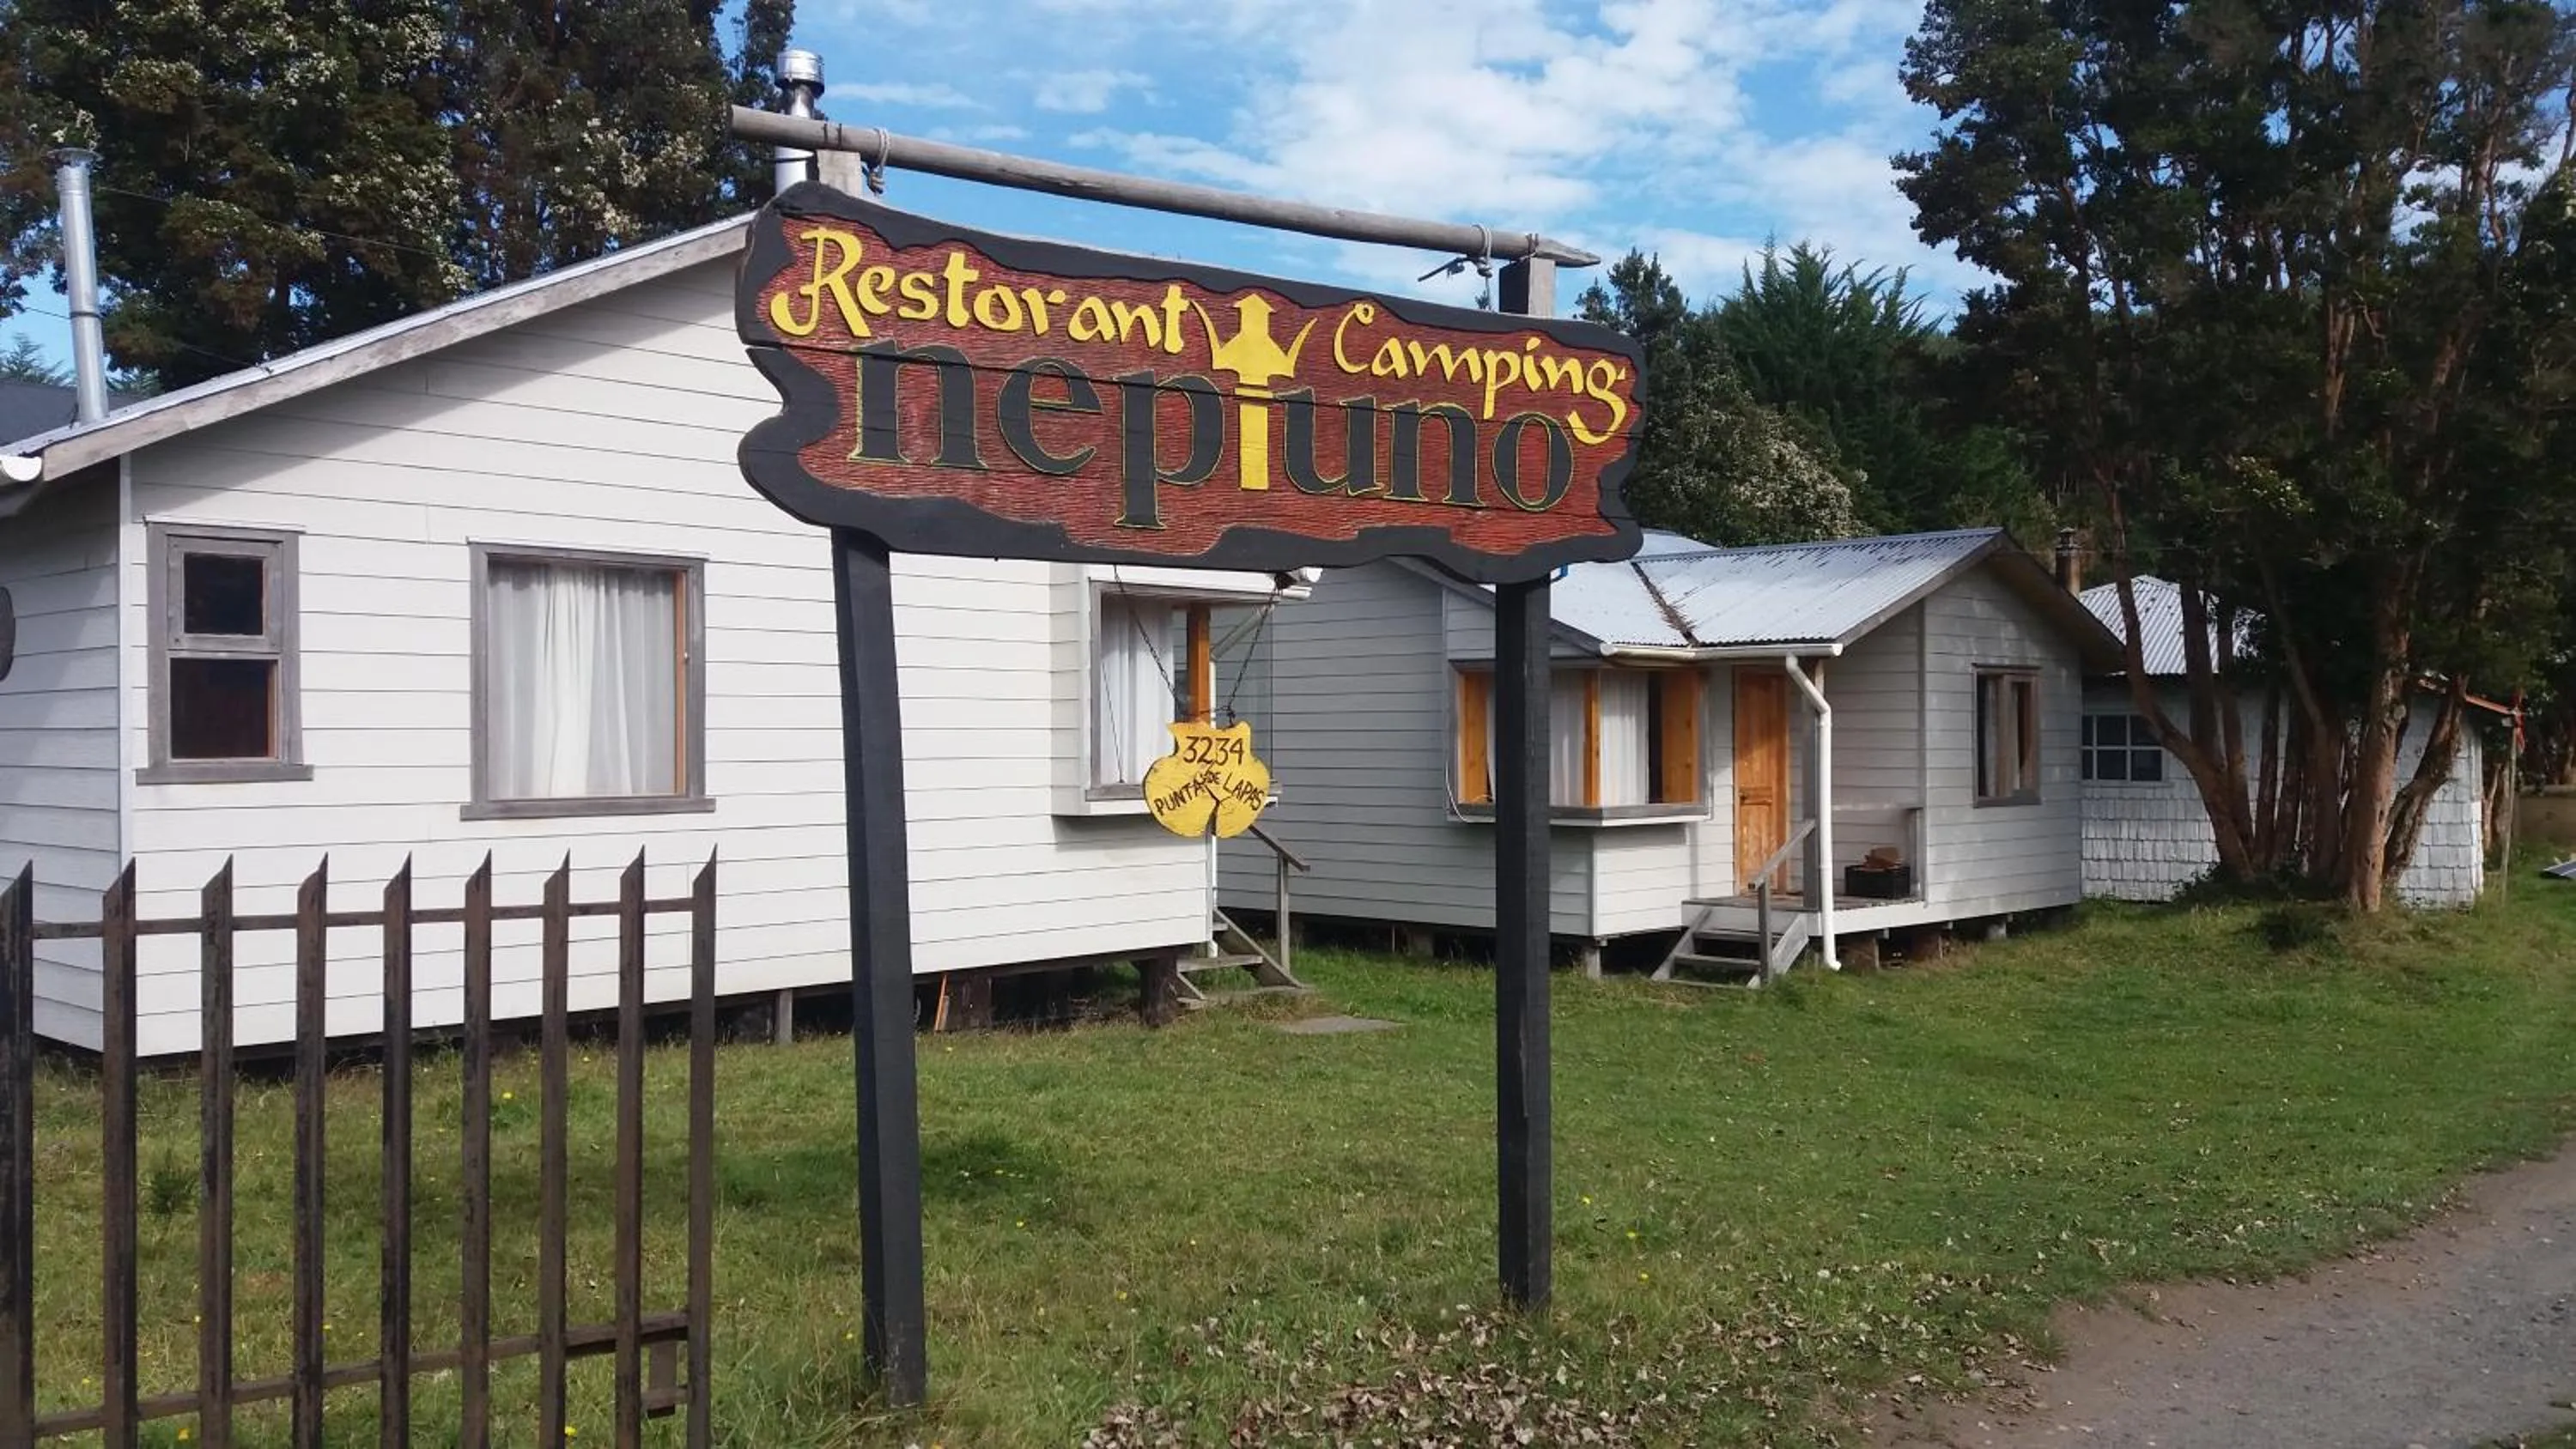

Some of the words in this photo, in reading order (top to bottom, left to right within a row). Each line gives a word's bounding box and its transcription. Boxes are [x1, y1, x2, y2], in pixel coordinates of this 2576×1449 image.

[770, 227, 1189, 354] Restorant
[1334, 302, 1627, 445] Camping
[1182, 736, 1245, 766] 3234
[1153, 778, 1206, 816] PUNTA
[1222, 772, 1265, 812] LAPAS
